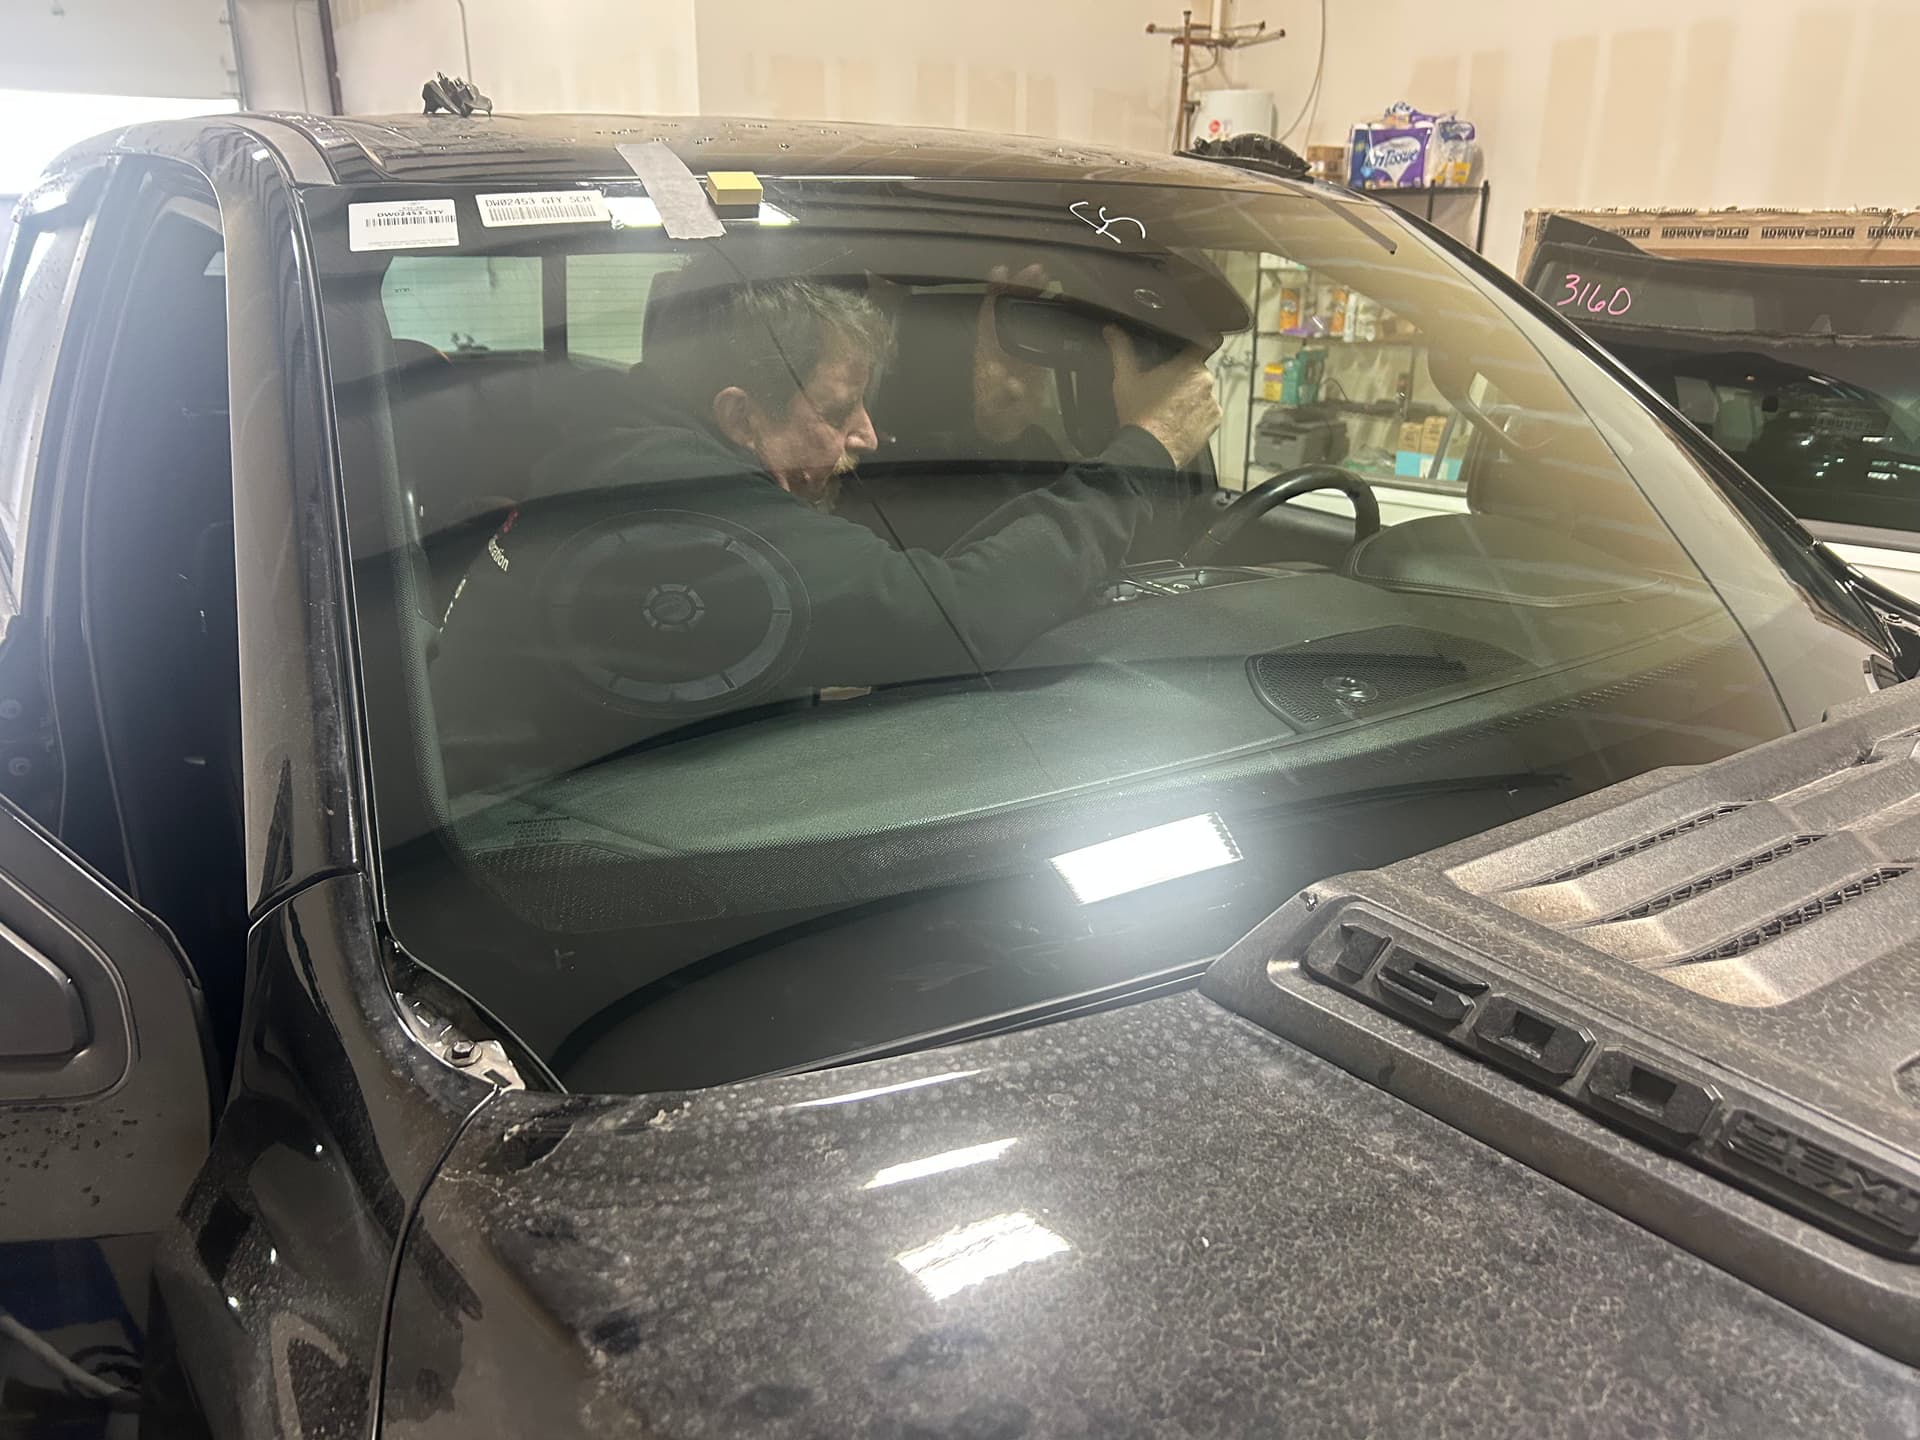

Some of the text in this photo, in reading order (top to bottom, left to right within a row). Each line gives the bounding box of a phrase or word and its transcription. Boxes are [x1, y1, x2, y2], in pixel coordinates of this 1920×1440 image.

[485, 198, 536, 207] DW02453
[542, 195, 562, 204] GTY
[1661, 227, 1749, 239] OPTIC ARMOR
[1761, 227, 1855, 239] OPTIC ARMOR
[1556, 274, 1632, 316] 3160
[1336, 922, 1722, 1136] 1500
